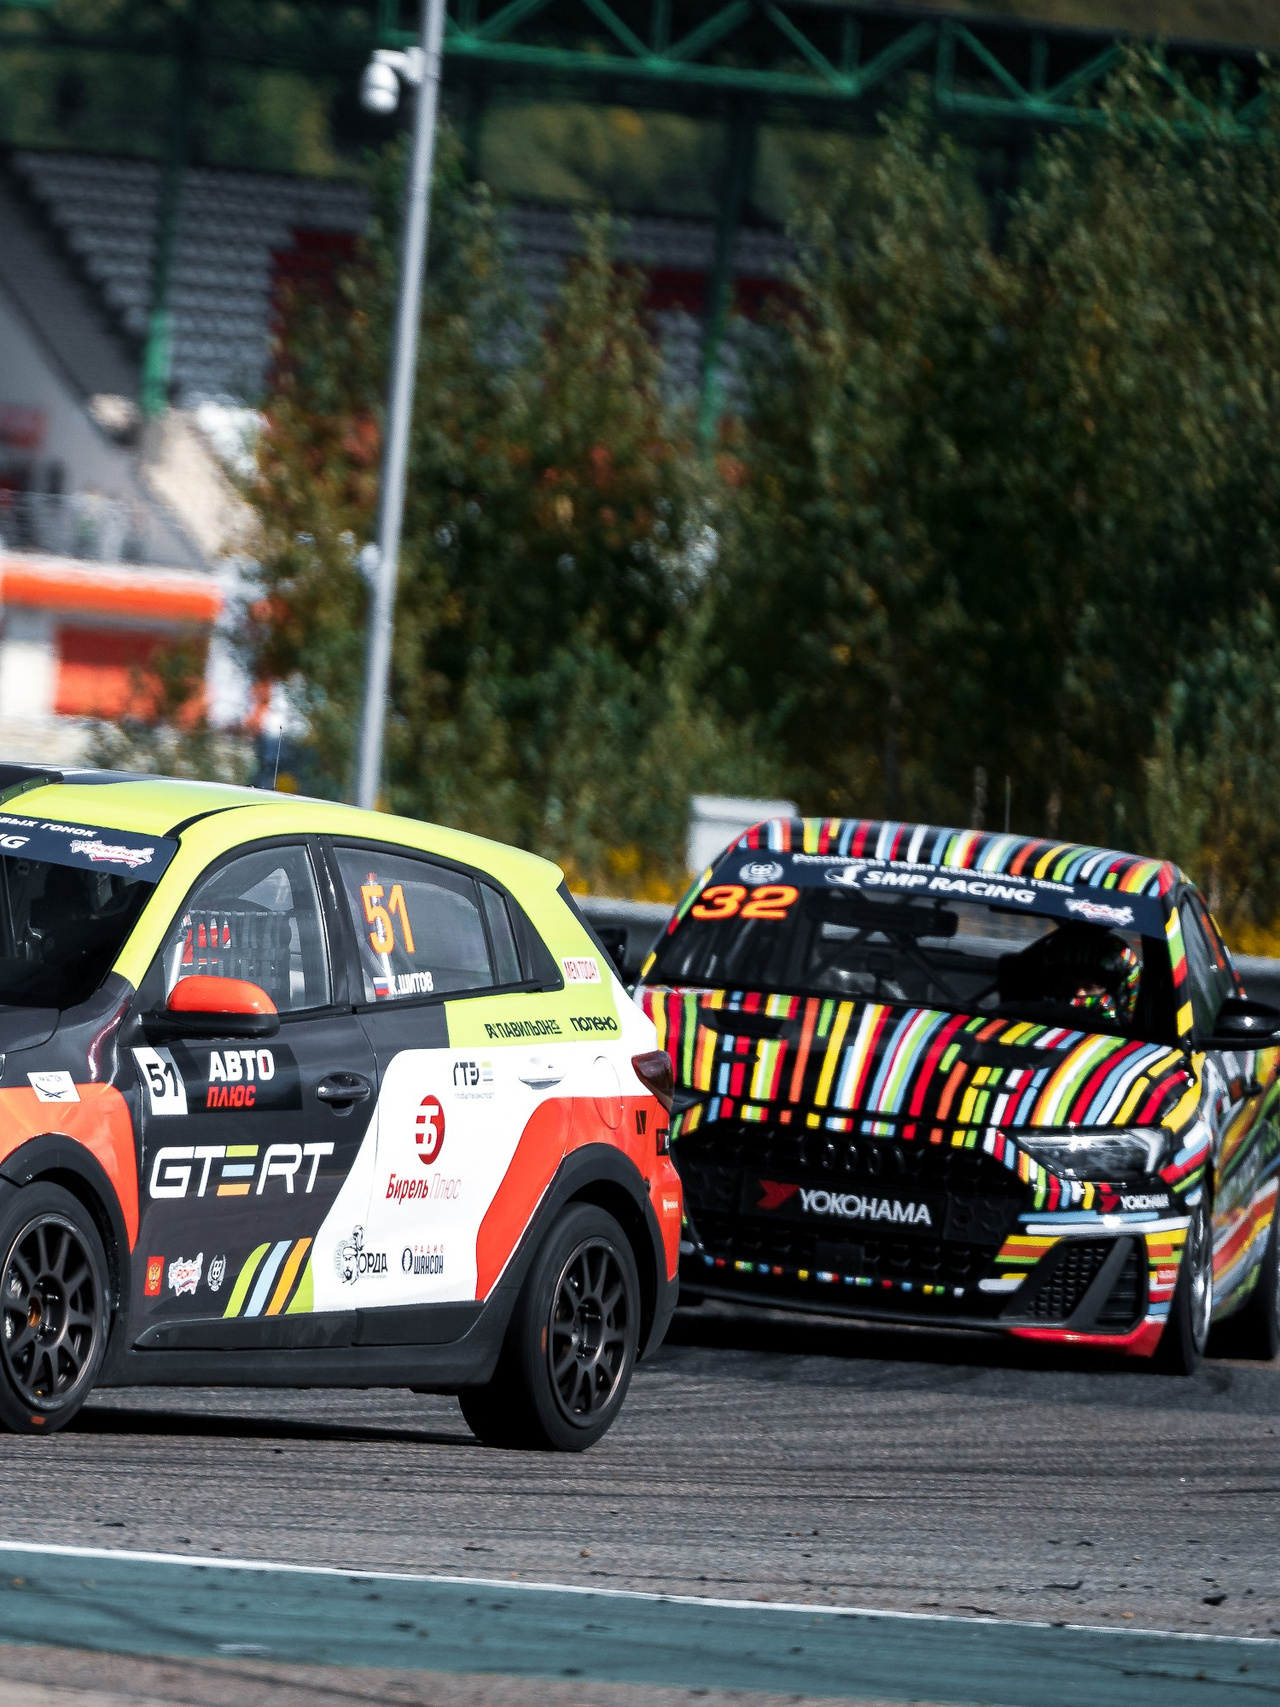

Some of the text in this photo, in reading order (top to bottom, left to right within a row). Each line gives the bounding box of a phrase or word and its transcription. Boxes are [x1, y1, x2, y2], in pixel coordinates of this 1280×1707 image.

[40, 822, 98, 837] гонок
[691, 884, 800, 920] 32
[863, 870, 1037, 904] SMP RACING
[360, 884, 416, 954] 51
[145, 1062, 179, 1097] 51
[208, 1049, 275, 1082] АВТО
[206, 1085, 257, 1108] ПЛЮС
[385, 1173, 462, 1205] Бирель Плюс
[799, 1187, 933, 1227] YOKOHAMA
[413, 1255, 444, 1274] ШАНСОН
